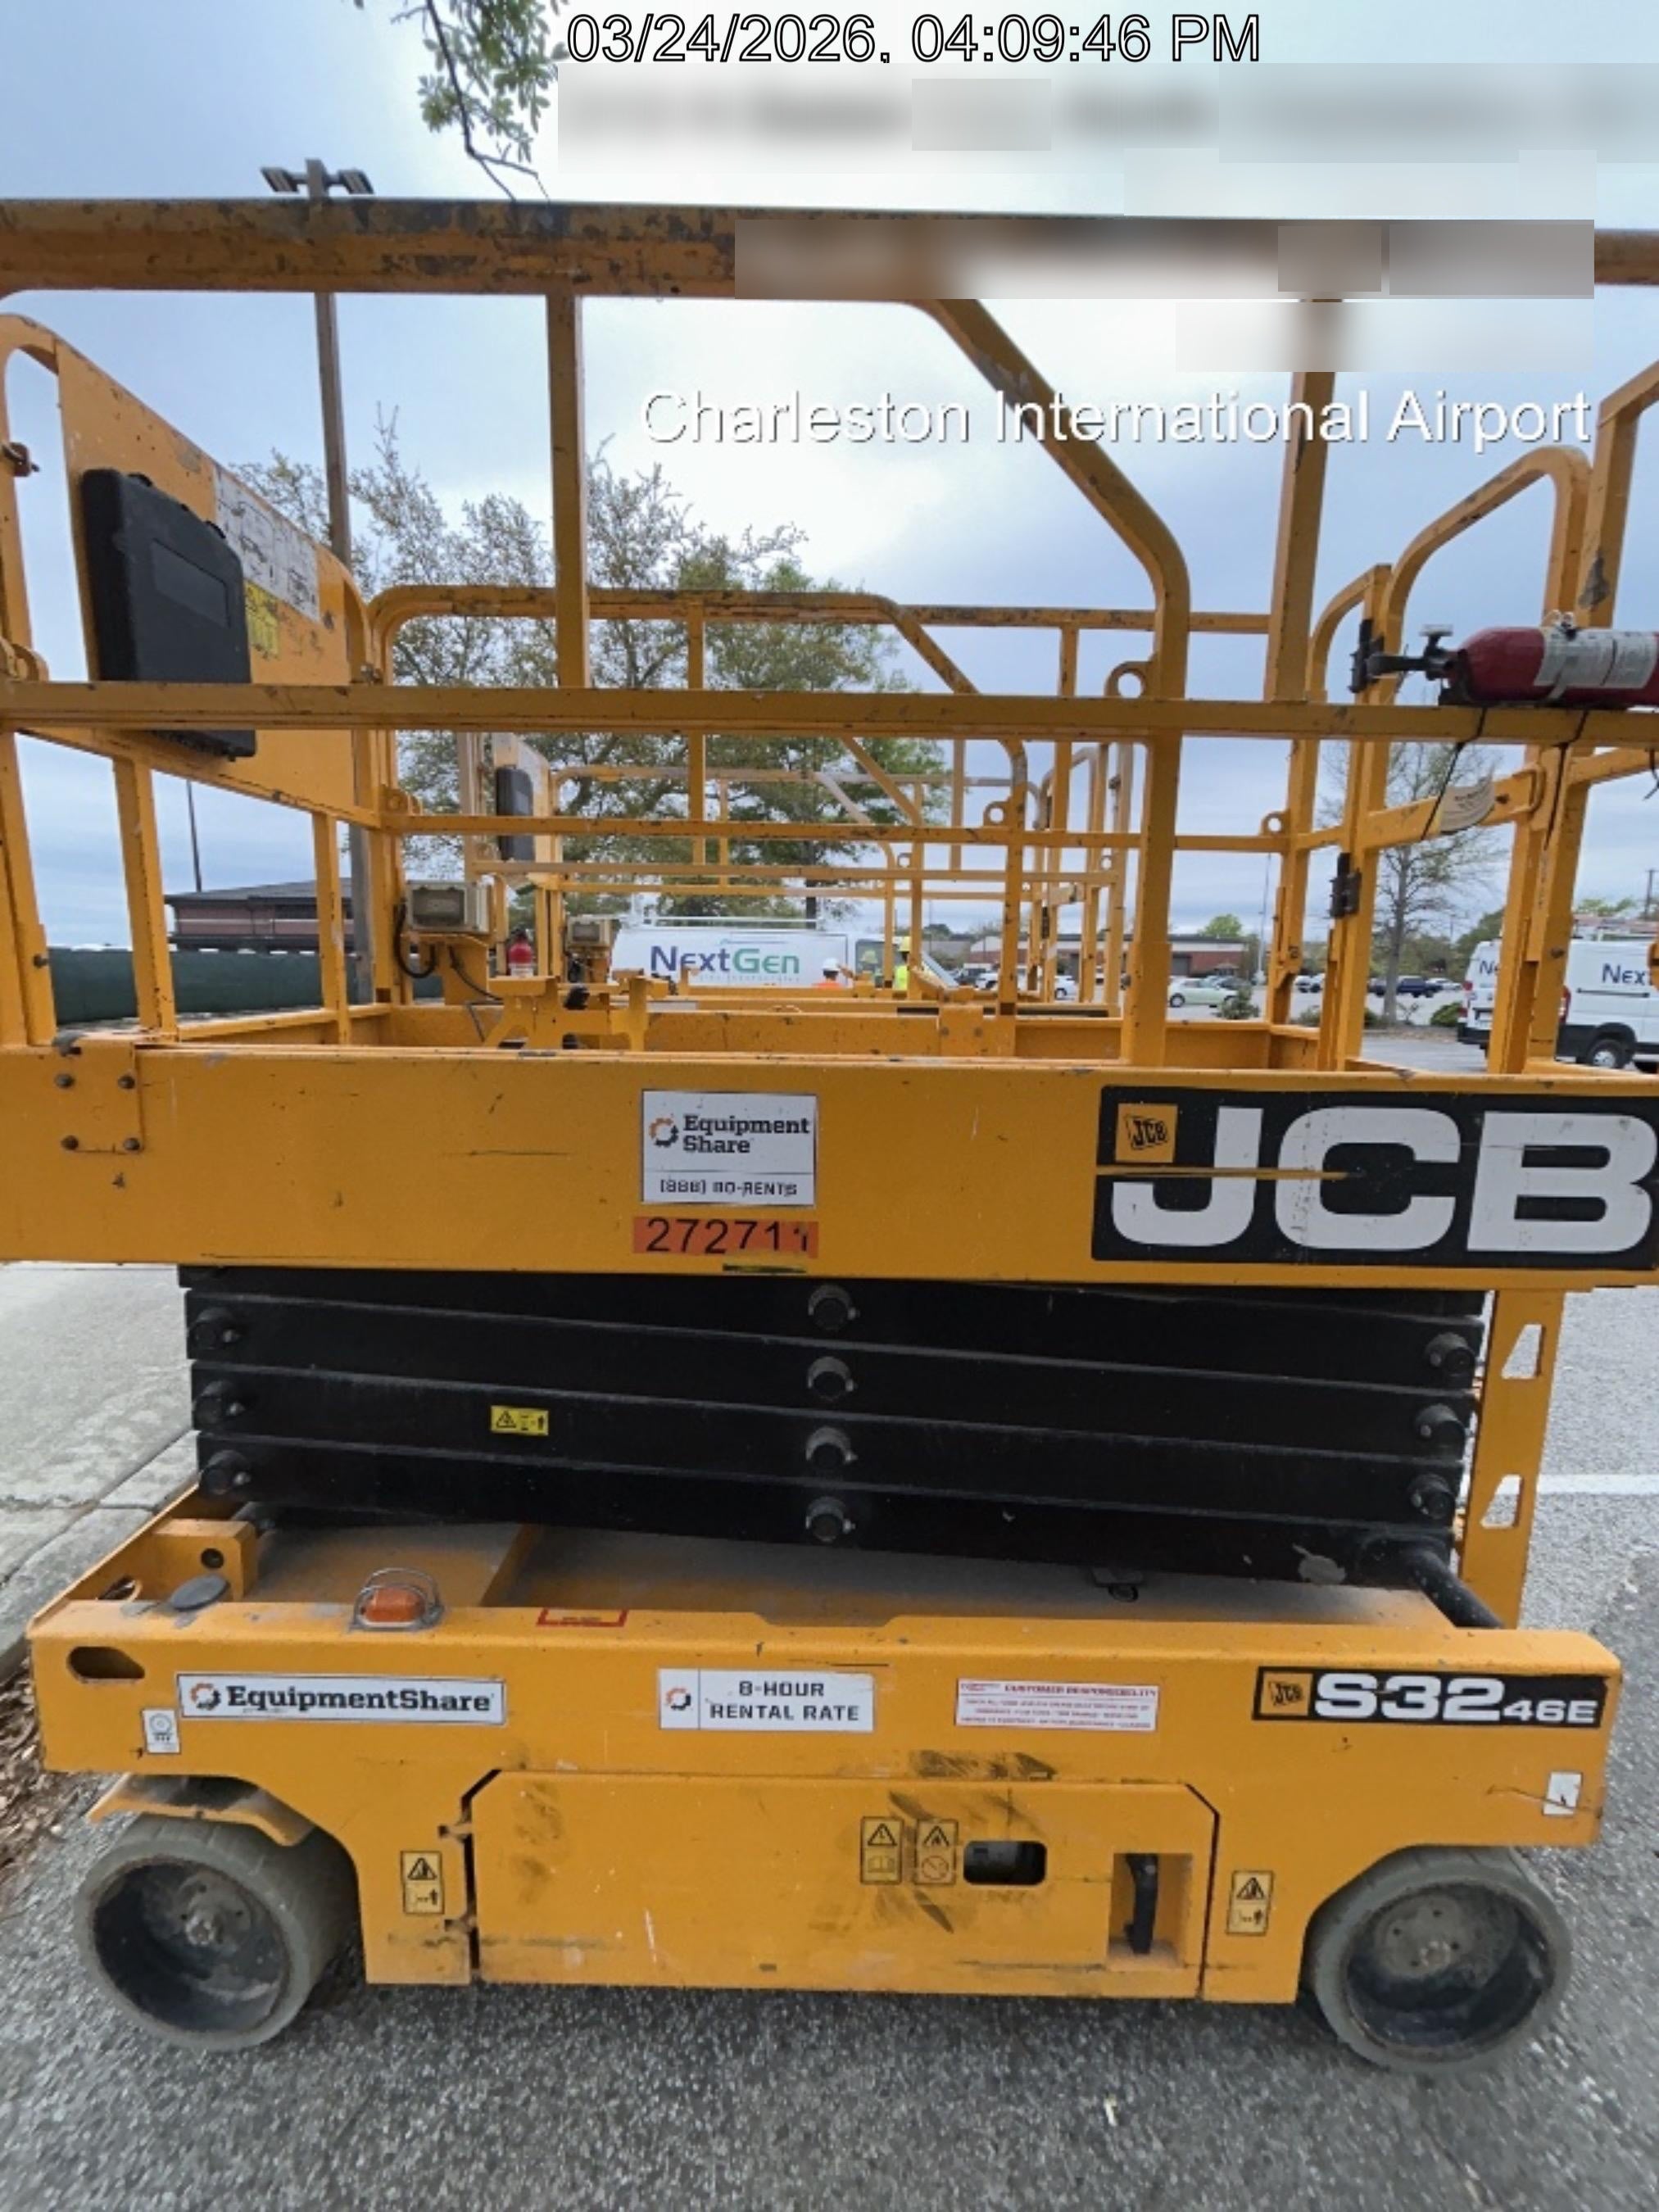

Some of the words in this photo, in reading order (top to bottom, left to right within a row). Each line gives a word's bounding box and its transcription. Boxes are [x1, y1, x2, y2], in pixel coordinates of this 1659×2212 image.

[650, 945, 800, 974] NextGen
[683, 1115, 810, 1135] Equipment
[683, 1135, 750, 1154] Share
[1111, 1105, 1658, 1255] JCB
[227, 1685, 491, 1712] EquipmentShare
[739, 1680, 824, 1697] 8-HOUR
[709, 1704, 795, 1720] RENTAL
[803, 1705, 859, 1721] RATE
